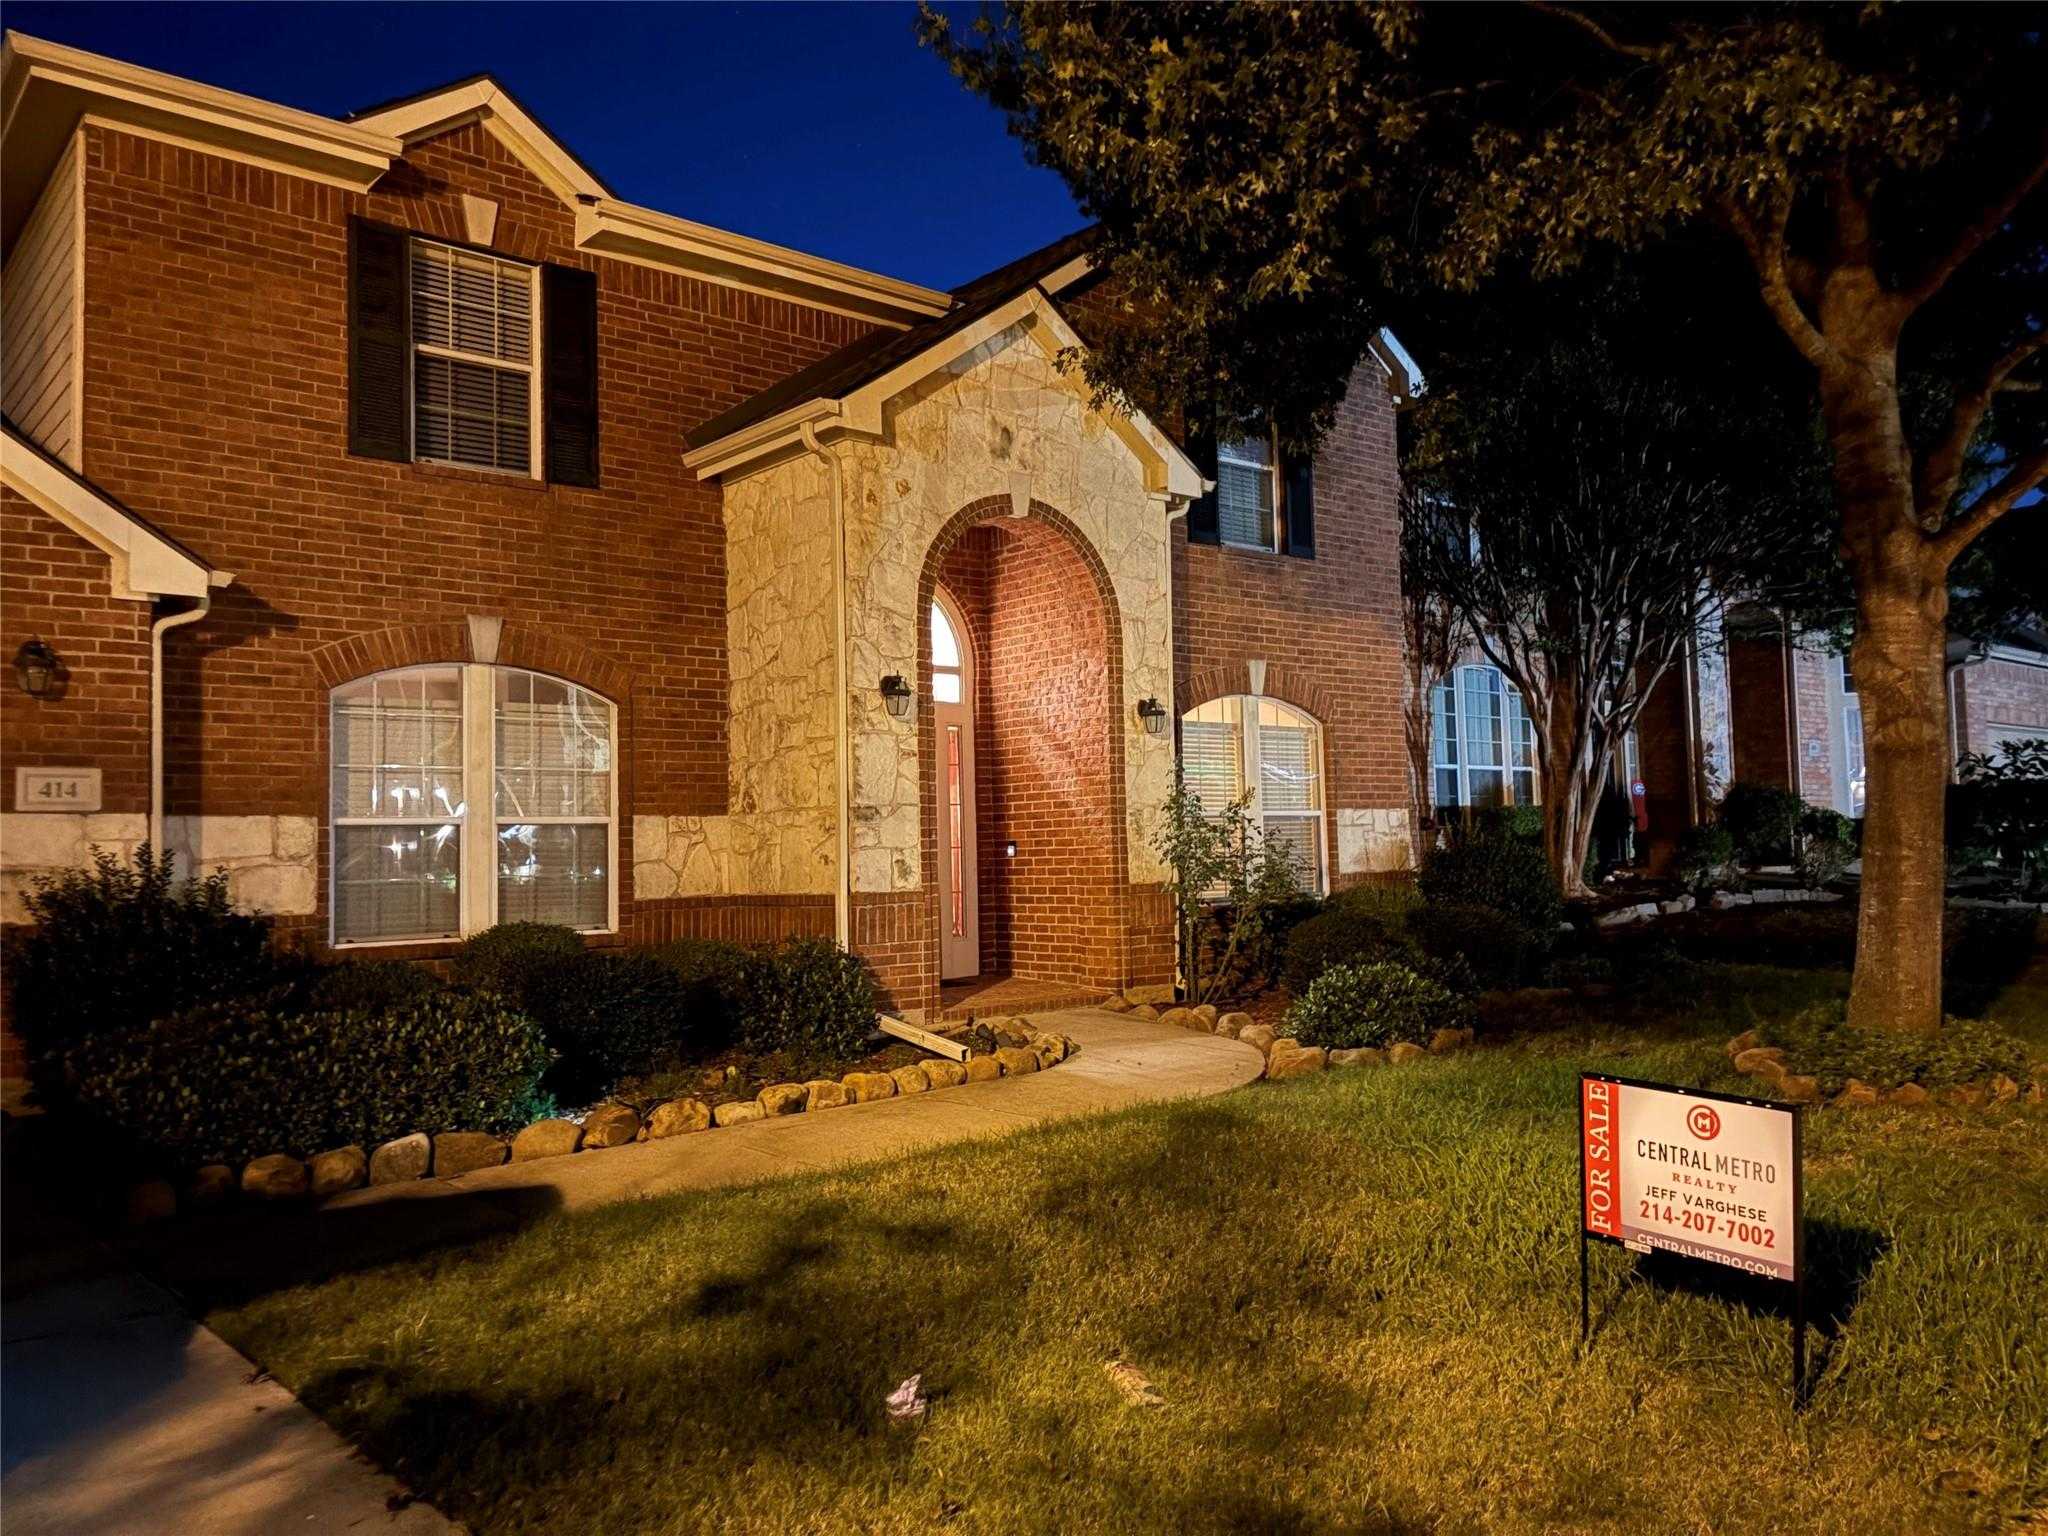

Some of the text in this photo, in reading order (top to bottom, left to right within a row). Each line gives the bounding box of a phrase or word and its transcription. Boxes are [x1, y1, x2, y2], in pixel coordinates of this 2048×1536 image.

[38, 782, 77, 798] 414
[1588, 1083, 1612, 1232] FOR SALE
[1672, 1172, 1738, 1194] REALTY
[1640, 1200, 1775, 1249] 214-207-7002
[1645, 1185, 1767, 1223] JEFF VARGHESE
[1637, 1233, 1778, 1278] CENTRALMETRO.COM
